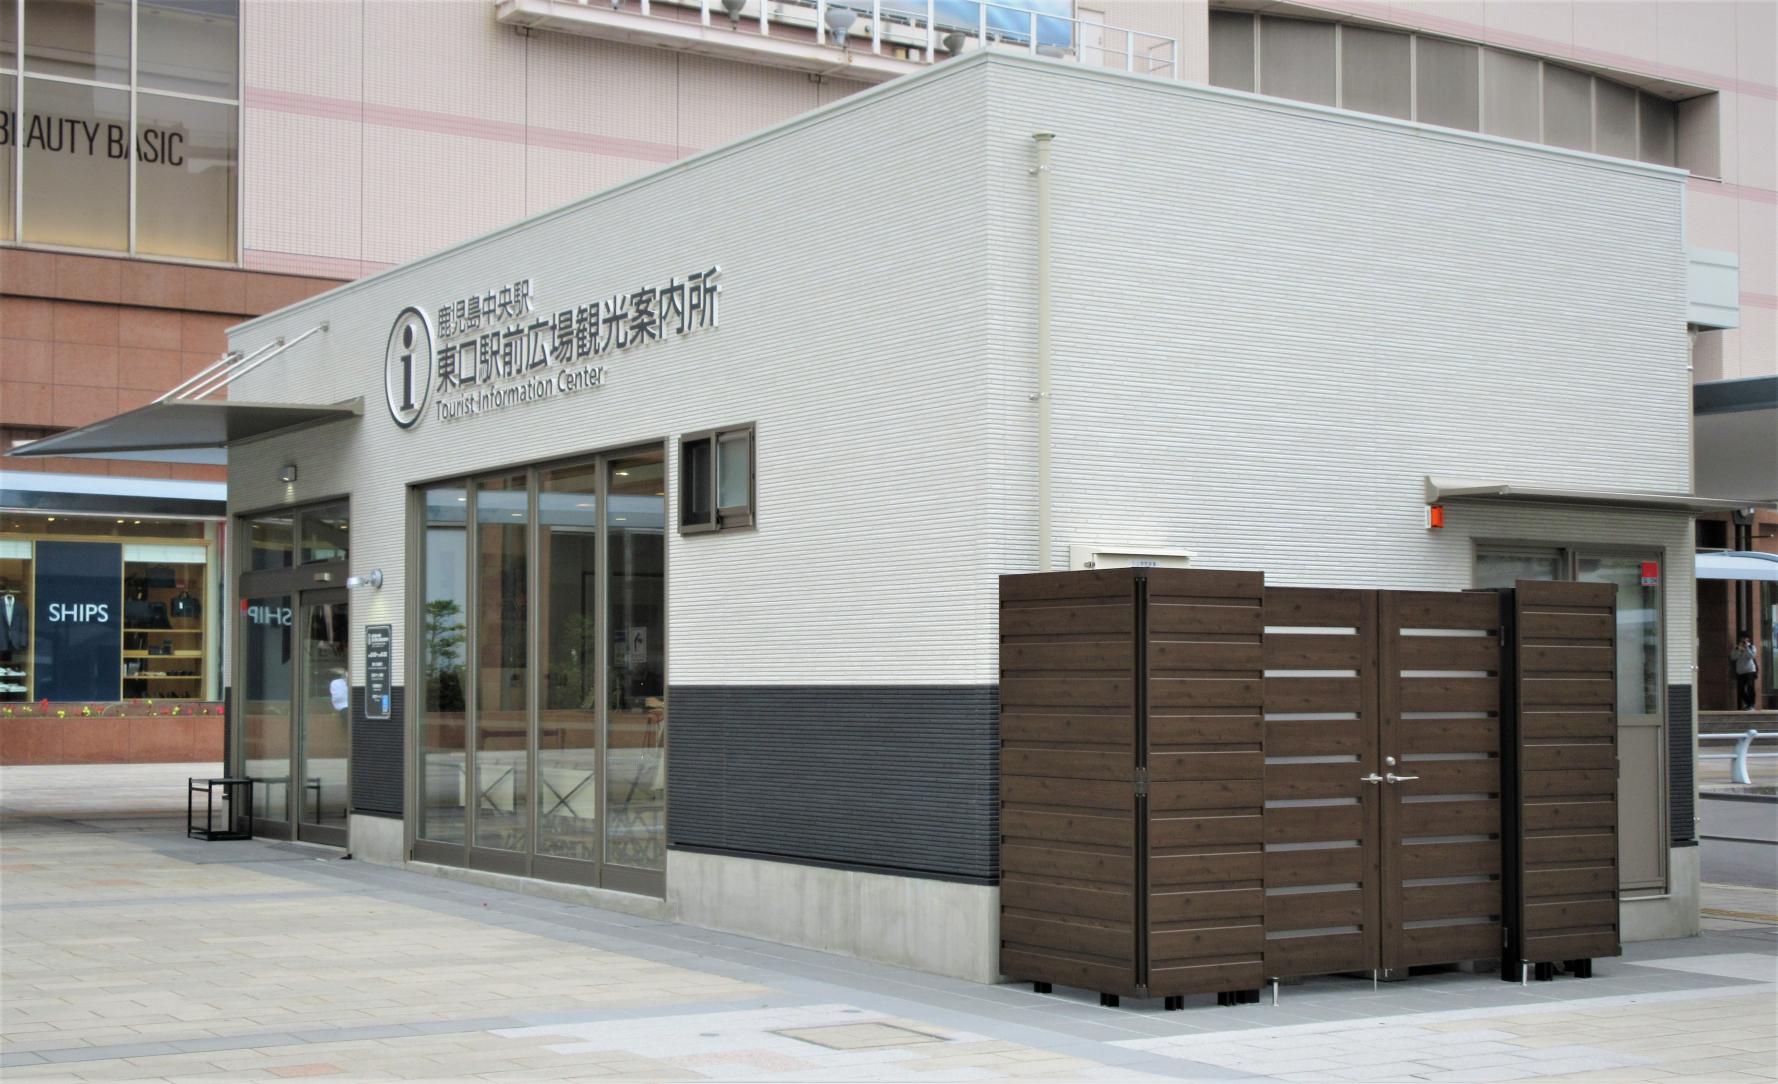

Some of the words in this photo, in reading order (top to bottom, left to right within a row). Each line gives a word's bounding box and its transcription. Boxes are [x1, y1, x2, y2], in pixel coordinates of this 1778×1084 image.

[436, 264, 722, 394] 東口駅前広場観光案内所
[438, 279, 533, 339] 鹿児島中央駅
[436, 394, 476, 421] Tourist
[477, 376, 554, 411] Information
[556, 365, 606, 393] Center
[48, 603, 109, 622] SHIPS
